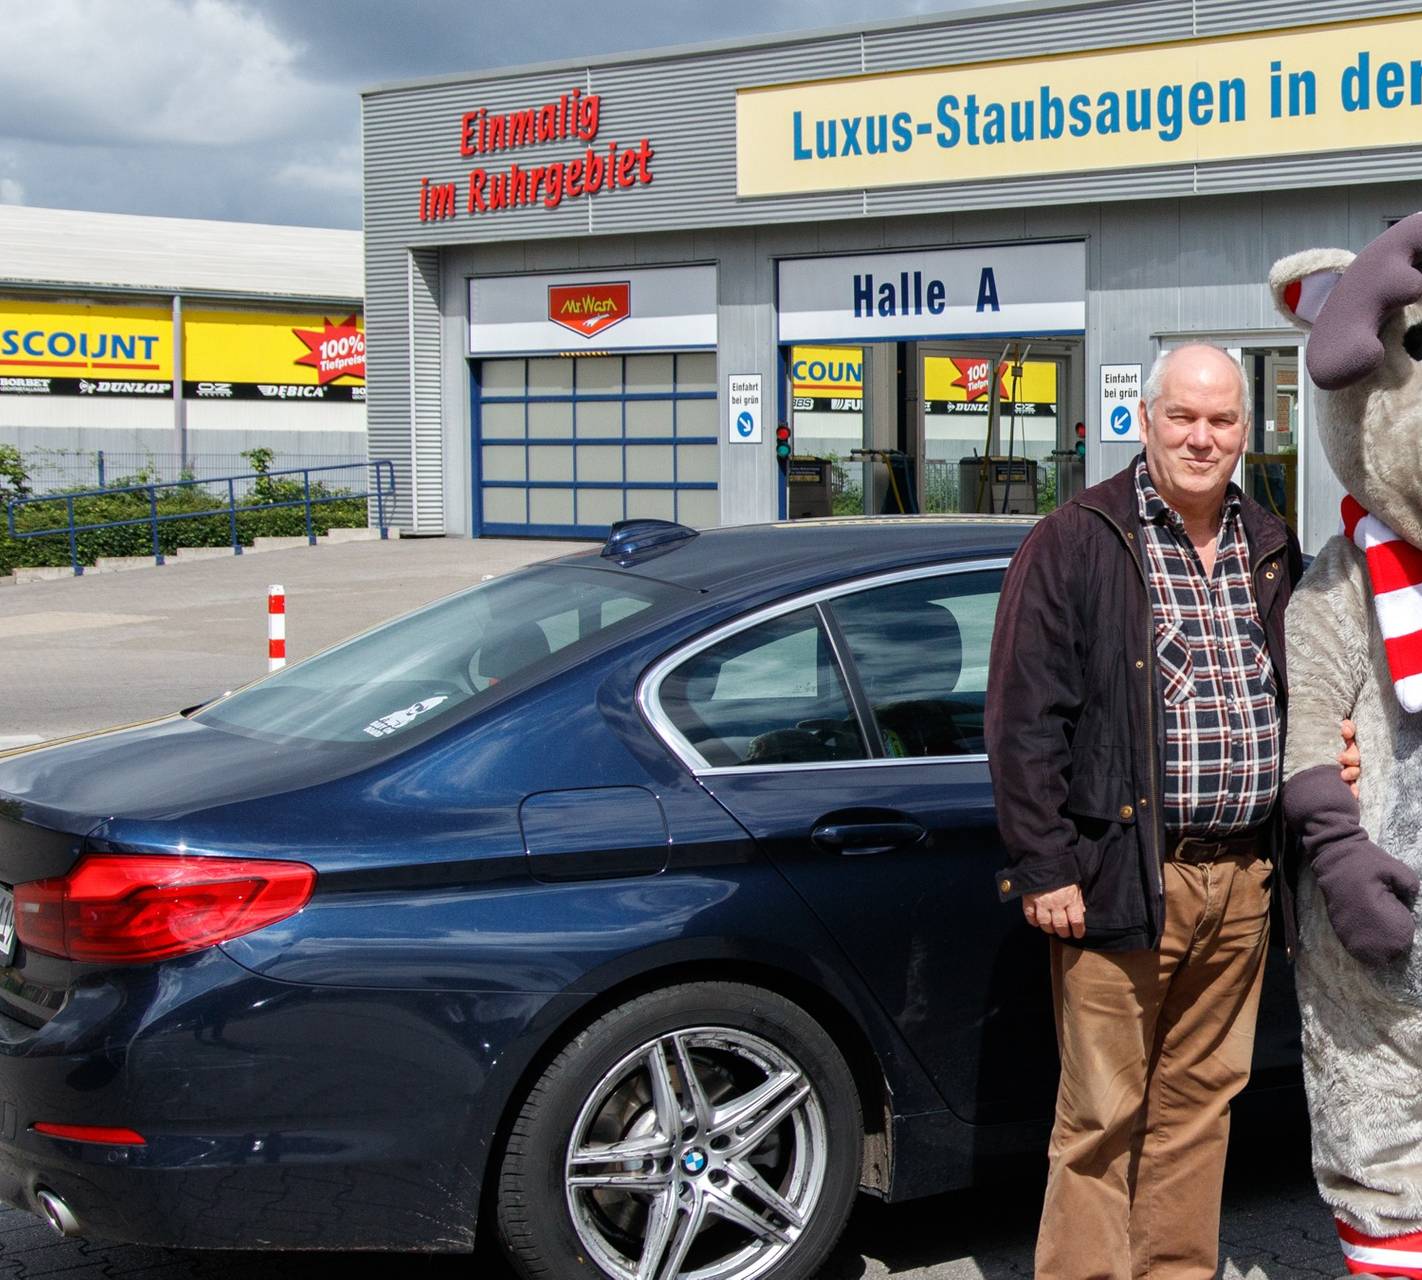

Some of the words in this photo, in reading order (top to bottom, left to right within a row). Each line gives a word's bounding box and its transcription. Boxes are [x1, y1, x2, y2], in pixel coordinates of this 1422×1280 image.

[793, 76, 1246, 161] Luxus-Staubsaugen
[1270, 61, 1316, 119] in
[460, 87, 601, 157] Einmalig
[419, 177, 455, 223] im
[467, 138, 655, 208] Ruhrgebiet
[853, 270, 947, 319] Halle
[976, 267, 1000, 313] A
[319, 334, 364, 360] 100%
[967, 363, 989, 381] 100
[1104, 373, 1138, 384] Einfahrt
[97, 382, 171, 394] DUNLOP
[732, 383, 759, 392] Einfahrt
[1104, 388, 1117, 398] bei
[1119, 388, 1138, 400] grün
[731, 395, 742, 405] bei
[744, 396, 759, 406] grün
